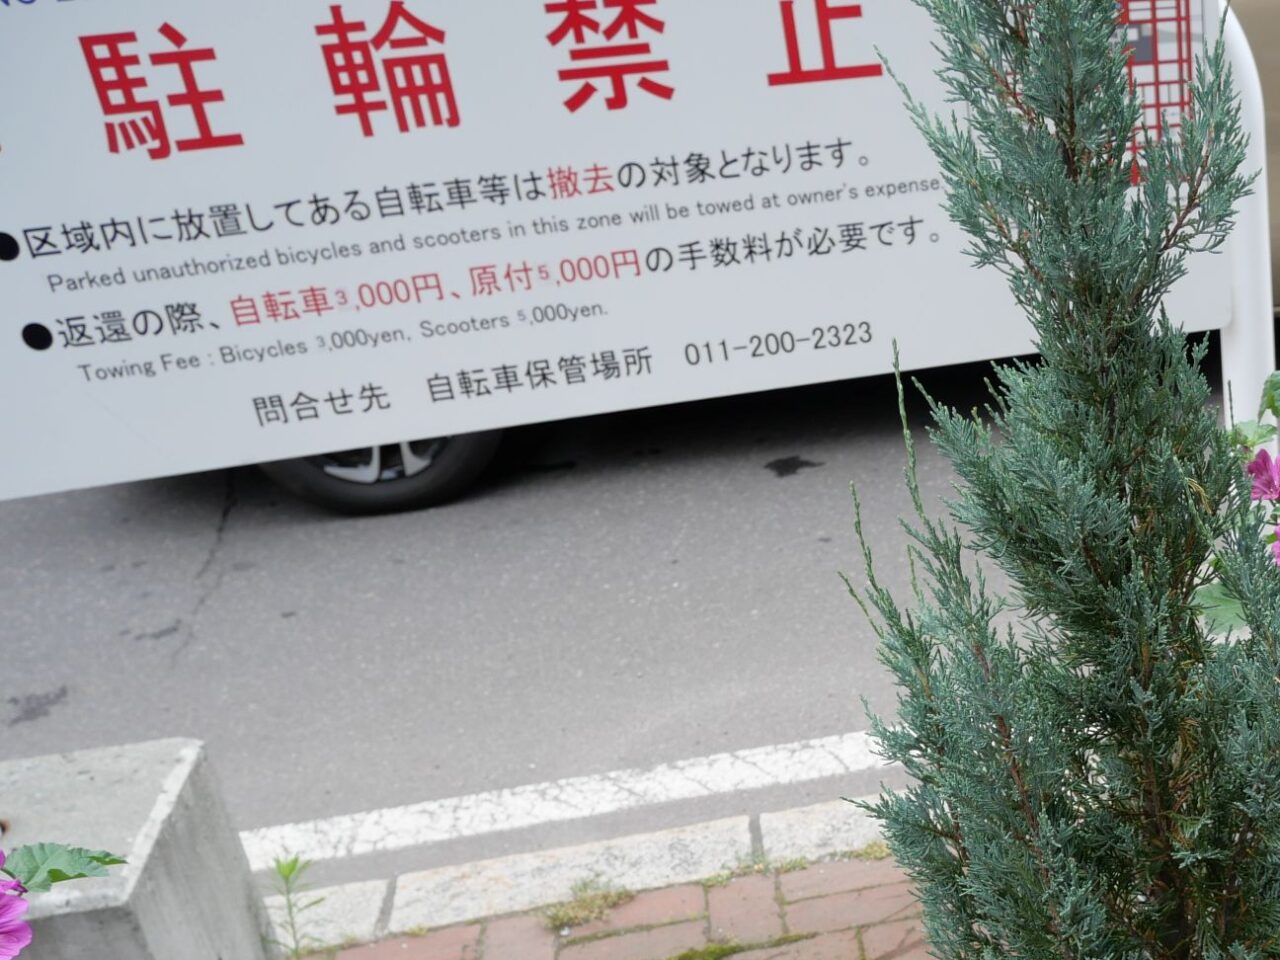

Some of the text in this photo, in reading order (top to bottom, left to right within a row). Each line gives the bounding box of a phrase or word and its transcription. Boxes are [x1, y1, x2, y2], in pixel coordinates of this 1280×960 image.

[78, 0, 883, 161] 駐輪禁止
[47, 267, 126, 293] Parked
[133, 250, 272, 283] unauthorized
[275, 241, 363, 267] bicycles
[369, 233, 406, 254] and
[413, 226, 502, 250] scooters
[507, 221, 527, 239] in
[532, 215, 569, 236] this
[577, 213, 622, 231] zone
[630, 203, 660, 224] will
[665, 202, 690, 220] be
[696, 194, 755, 216] towed
[761, 193, 782, 210] at
[786, 182, 859, 206] owner's
[77, 358, 155, 382] Towing
[159, 353, 201, 372] Fee
[219, 339, 309, 364] Bicycles
[420, 312, 510, 338] Scooters
[252, 321, 874, 427] 問合せ先 自転車保管場所 011-200-2323
